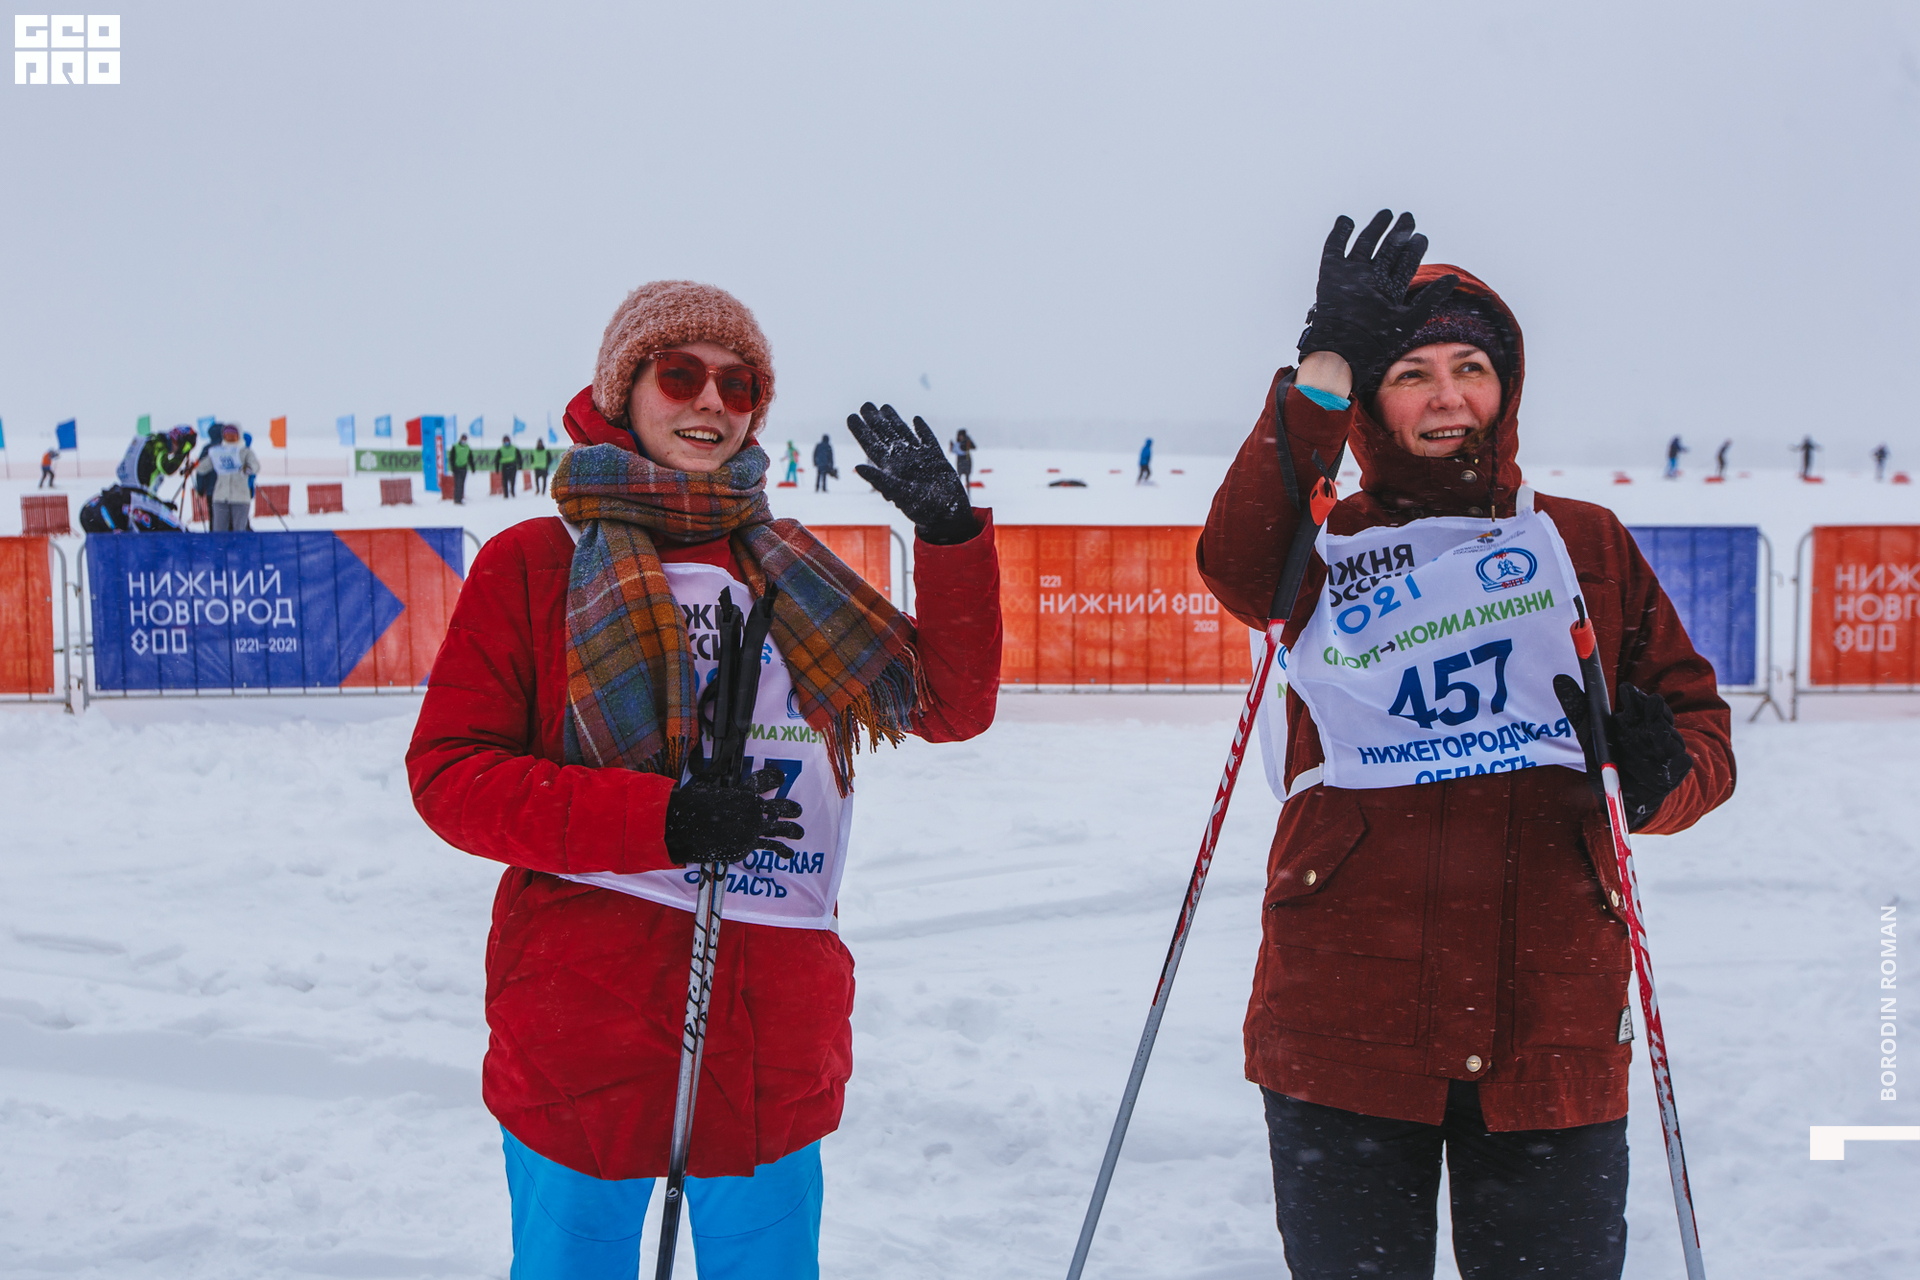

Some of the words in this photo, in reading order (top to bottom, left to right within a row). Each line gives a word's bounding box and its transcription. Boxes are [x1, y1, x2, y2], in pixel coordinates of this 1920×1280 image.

[129, 563, 281, 597] НИЖНИЙ
[1040, 575, 1061, 588] 1221
[1835, 563, 1920, 590] НИЖ
[130, 598, 296, 629] НОВГОРОД
[1040, 588, 1167, 614] НИЖНИЙ
[1171, 593, 1219, 615] 800
[1475, 589, 1555, 624] ЖИЗНИ
[1834, 593, 1920, 622] НОВГ
[1193, 620, 1219, 633] 2021
[1388, 638, 1513, 730] 457
[1357, 716, 1572, 765] НИЖЕГОРОДСКАЯ
